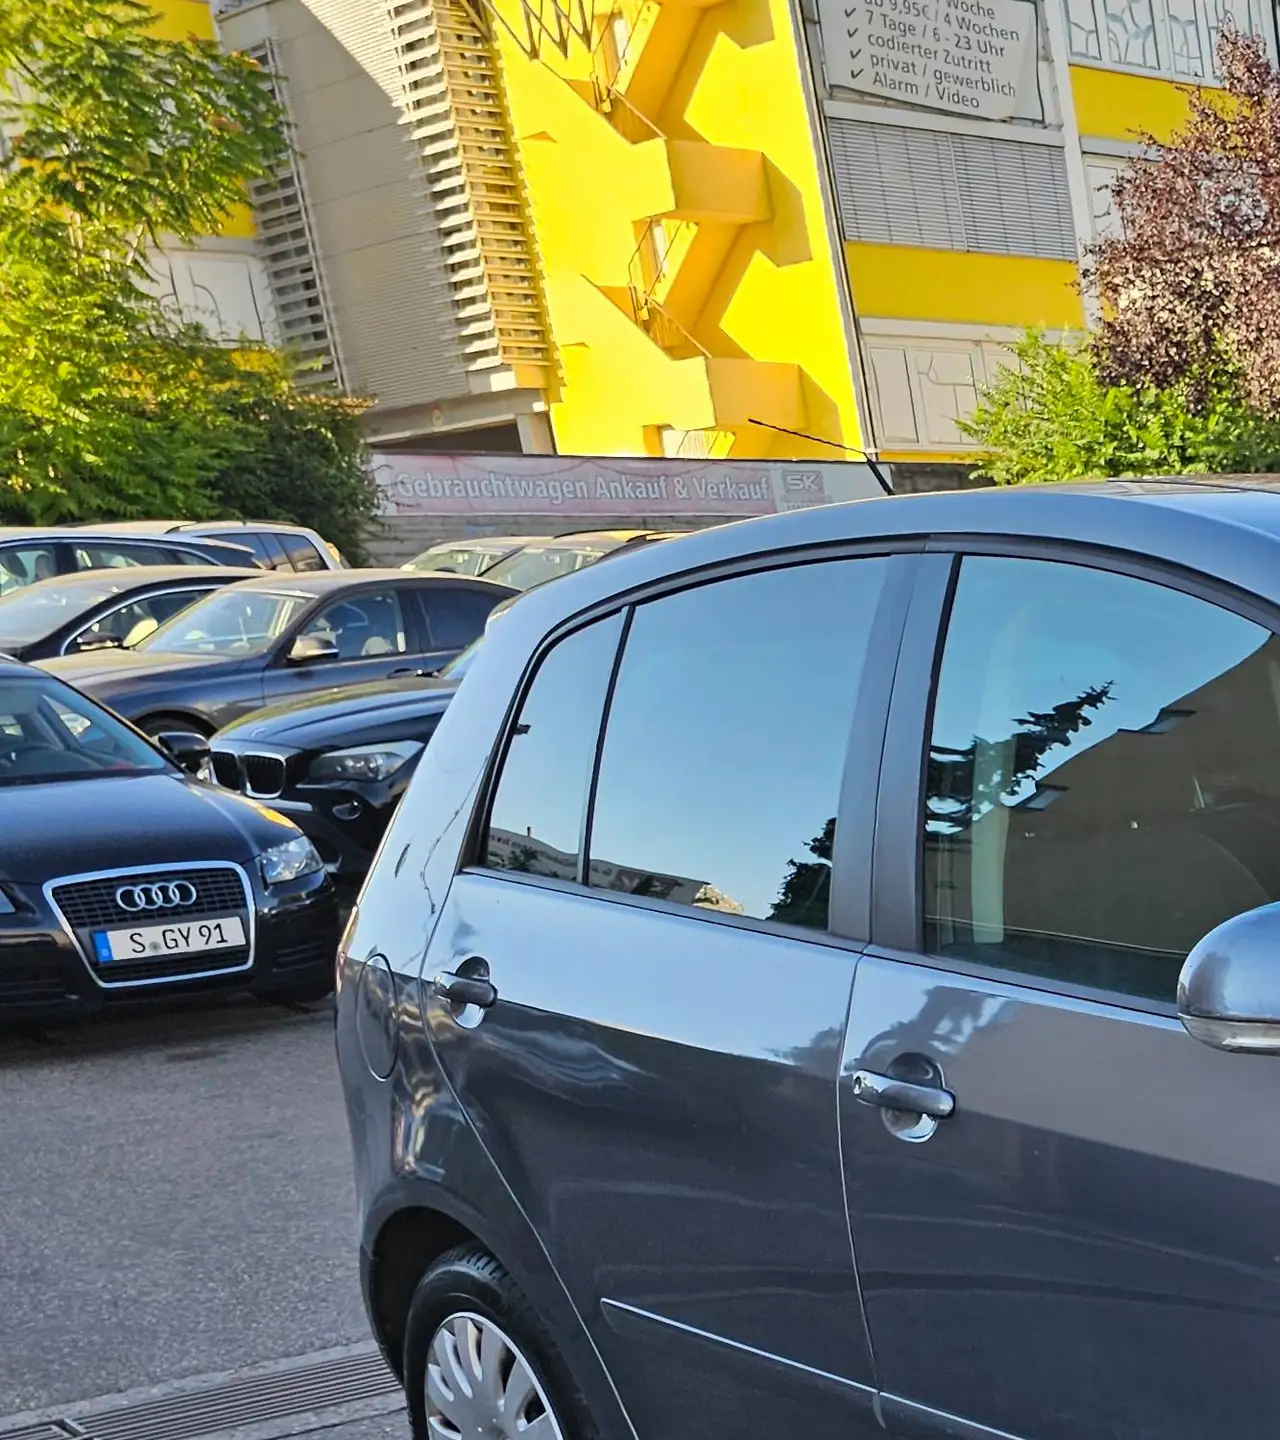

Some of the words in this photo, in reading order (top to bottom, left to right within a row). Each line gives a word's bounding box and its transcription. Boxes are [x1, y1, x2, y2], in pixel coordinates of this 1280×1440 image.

[865, 9, 874, 25] 7
[880, 13, 916, 37] Tage
[932, 27, 940, 42] 6
[954, 34, 972, 50] 23
[977, 39, 1005, 57] Uhr
[956, 15, 1020, 42] Wochen
[868, 33, 940, 60] codierter
[944, 50, 992, 74] Zutritt
[870, 53, 917, 75] privat
[934, 69, 1016, 98] gewerblich
[873, 71, 919, 95] Alarm
[936, 86, 980, 109] Video
[398, 472, 590, 504] Gebrauchtwagen
[594, 474, 670, 501] Ankauf
[674, 478, 690, 499] &
[695, 474, 770, 501] Verkauf
[786, 475, 820, 491] SK
[129, 932, 146, 954] S
[162, 927, 191, 950] GY
[198, 923, 228, 945] 91
